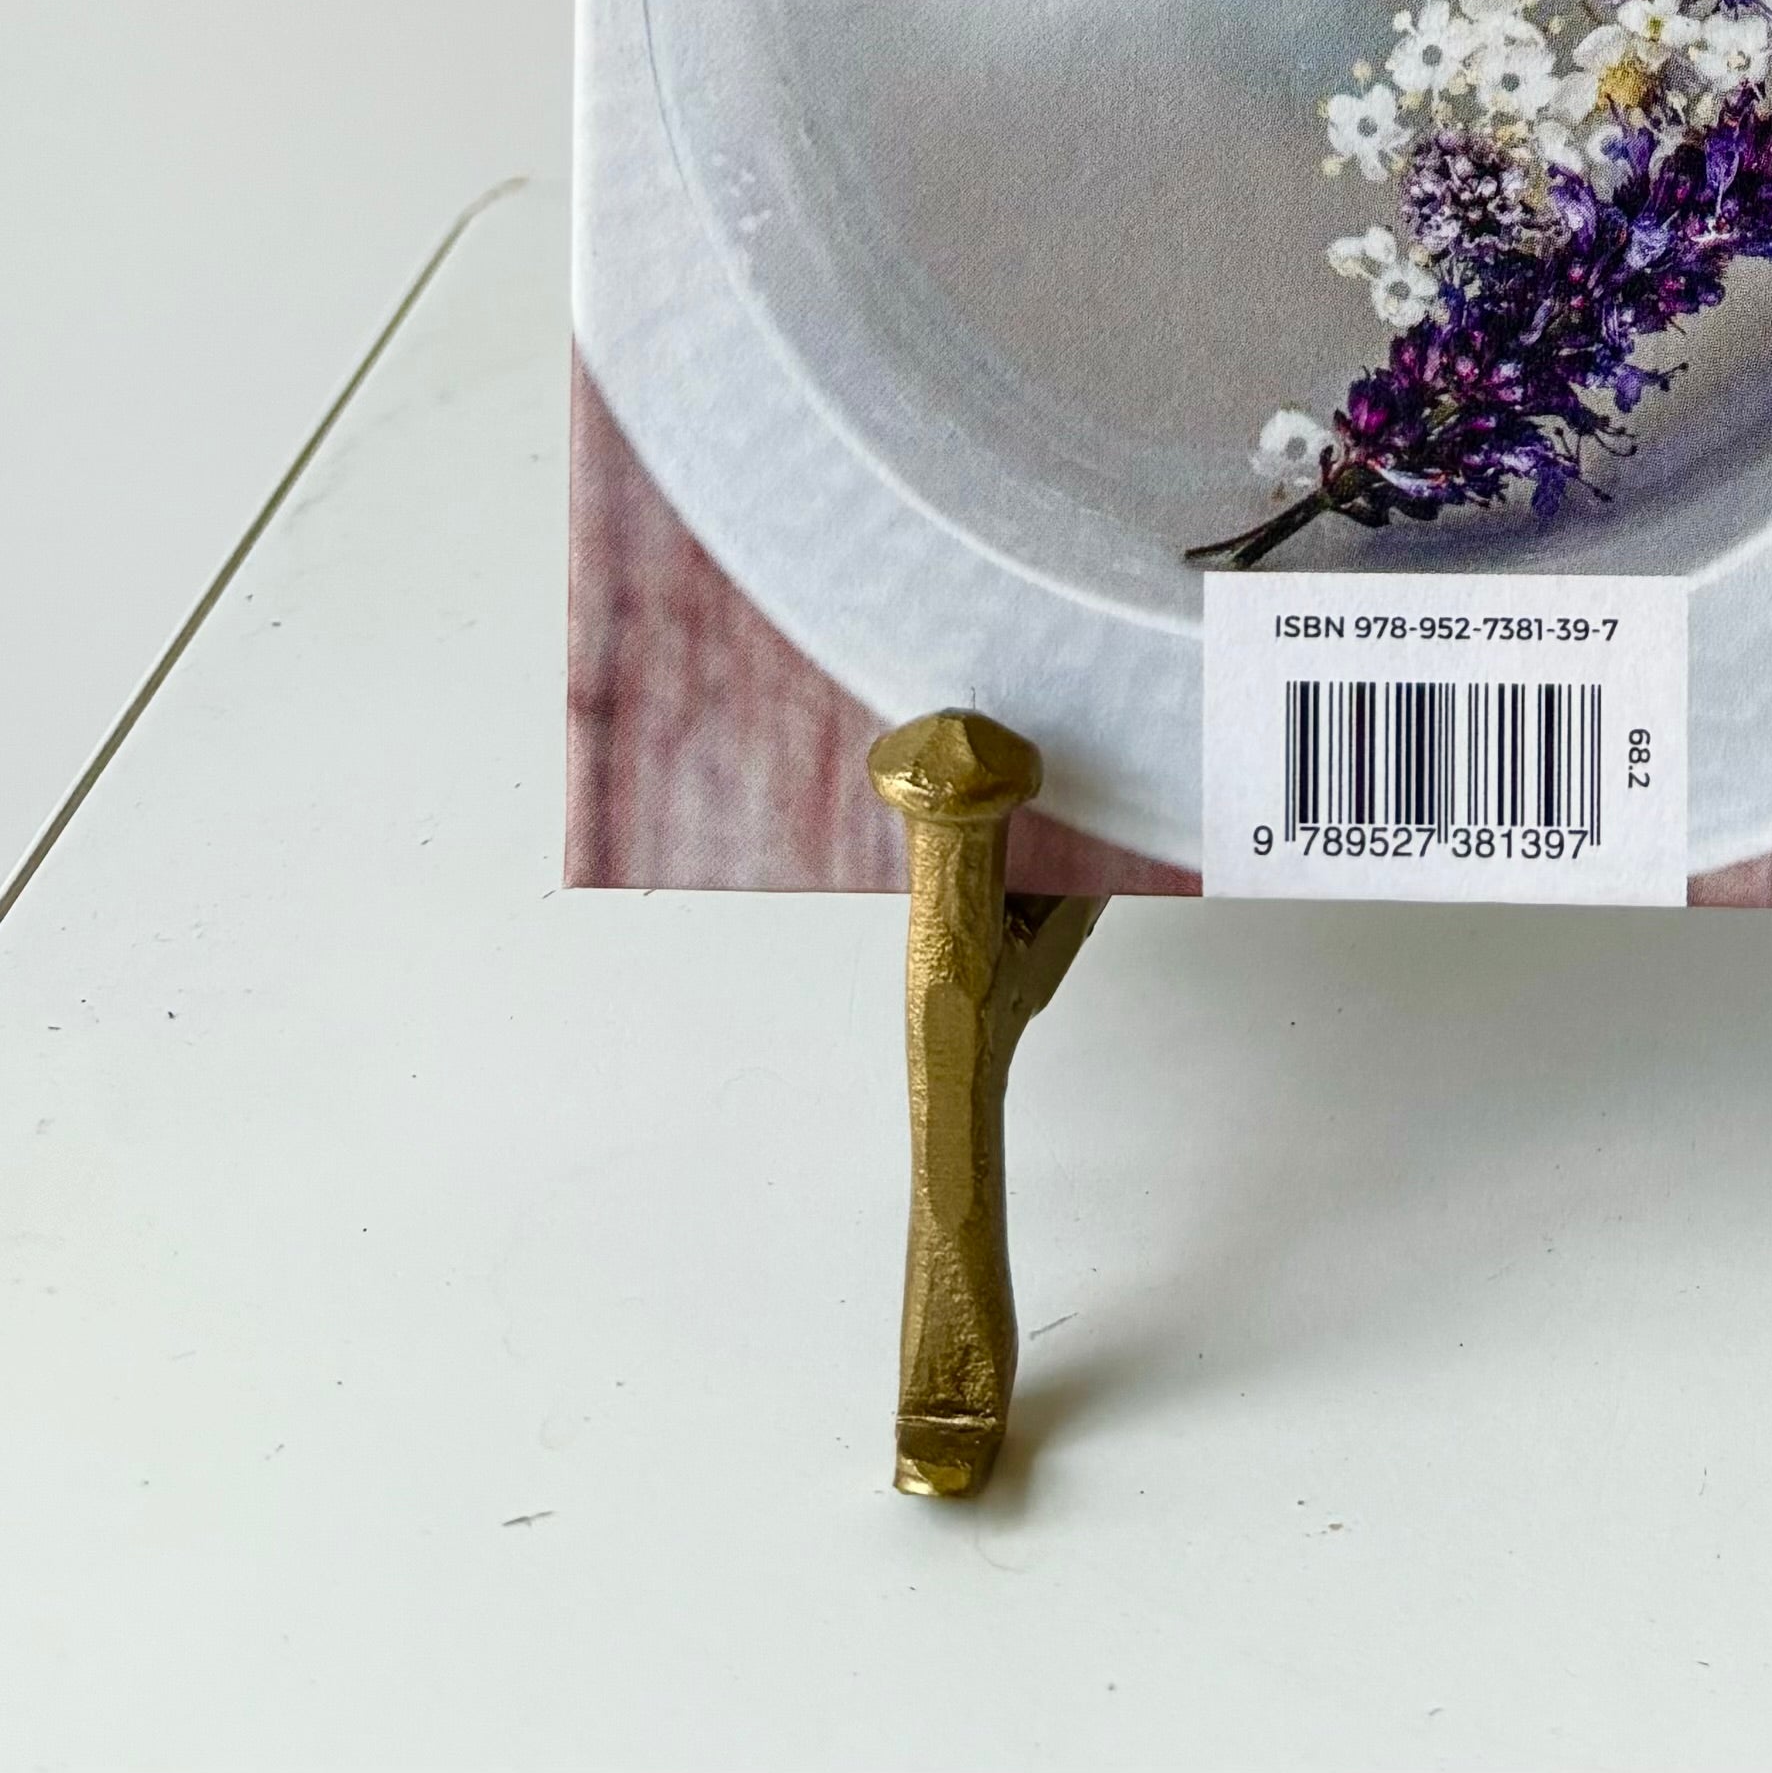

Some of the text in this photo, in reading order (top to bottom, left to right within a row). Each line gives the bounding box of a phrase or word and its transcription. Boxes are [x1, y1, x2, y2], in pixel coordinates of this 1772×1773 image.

[1276, 615, 1619, 642] ISBN 978-952-7381-39-7
[1628, 729, 1651, 789] 68.2
